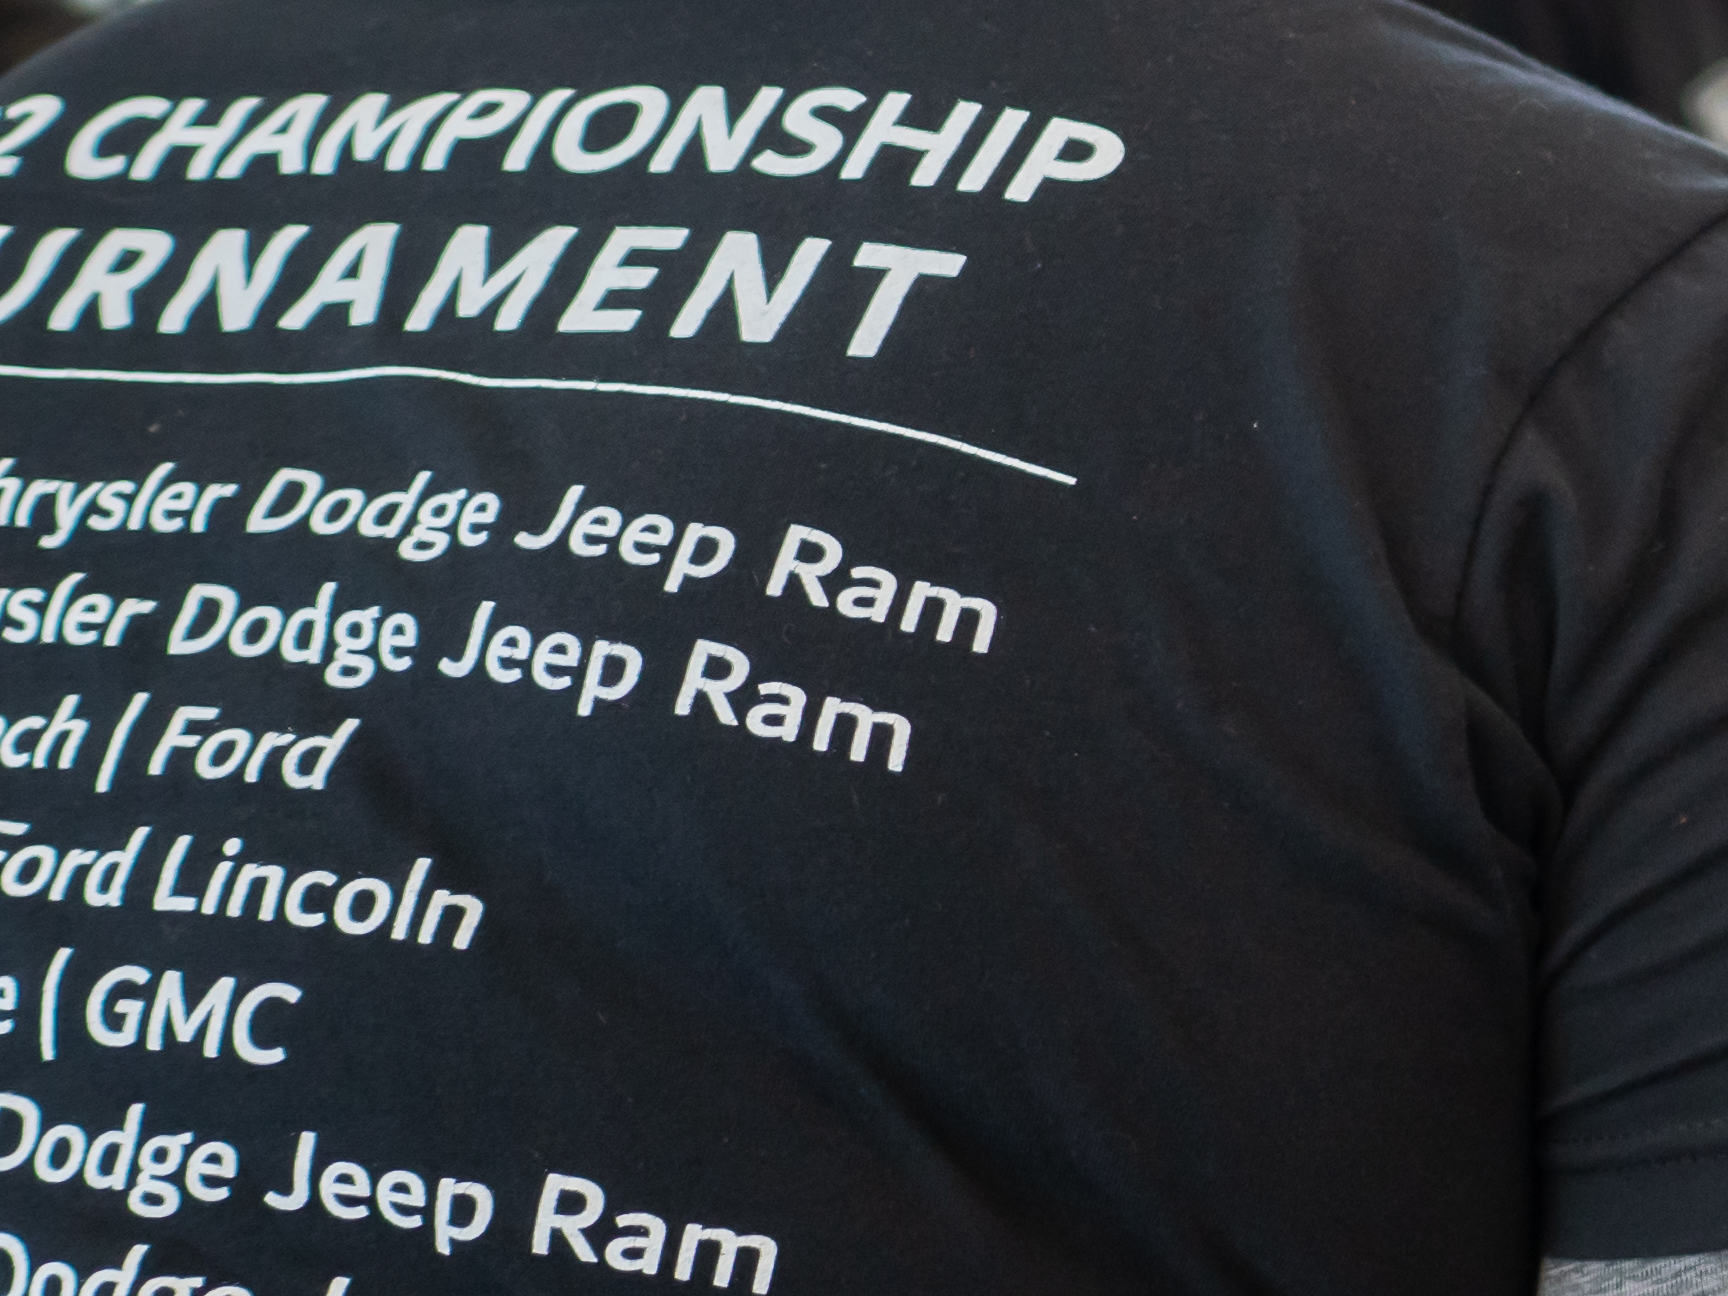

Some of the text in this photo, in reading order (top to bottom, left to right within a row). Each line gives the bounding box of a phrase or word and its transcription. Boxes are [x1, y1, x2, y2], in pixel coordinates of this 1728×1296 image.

[64, 83, 1127, 204] CHAMPIONSHIP
[244, 466, 502, 563] Dodge
[512, 483, 737, 594] Jeep
[764, 522, 999, 655] Ram
[0, 571, 913, 774] sler Dodge Jeep Ram
[0, 692, 91, 771] ch
[146, 704, 362, 792] Ford
[151, 833, 485, 951] Lincoln
[84, 963, 304, 1067] GMC
[262, 1129, 495, 1257] Jeep
[530, 1171, 779, 1296] Ram
